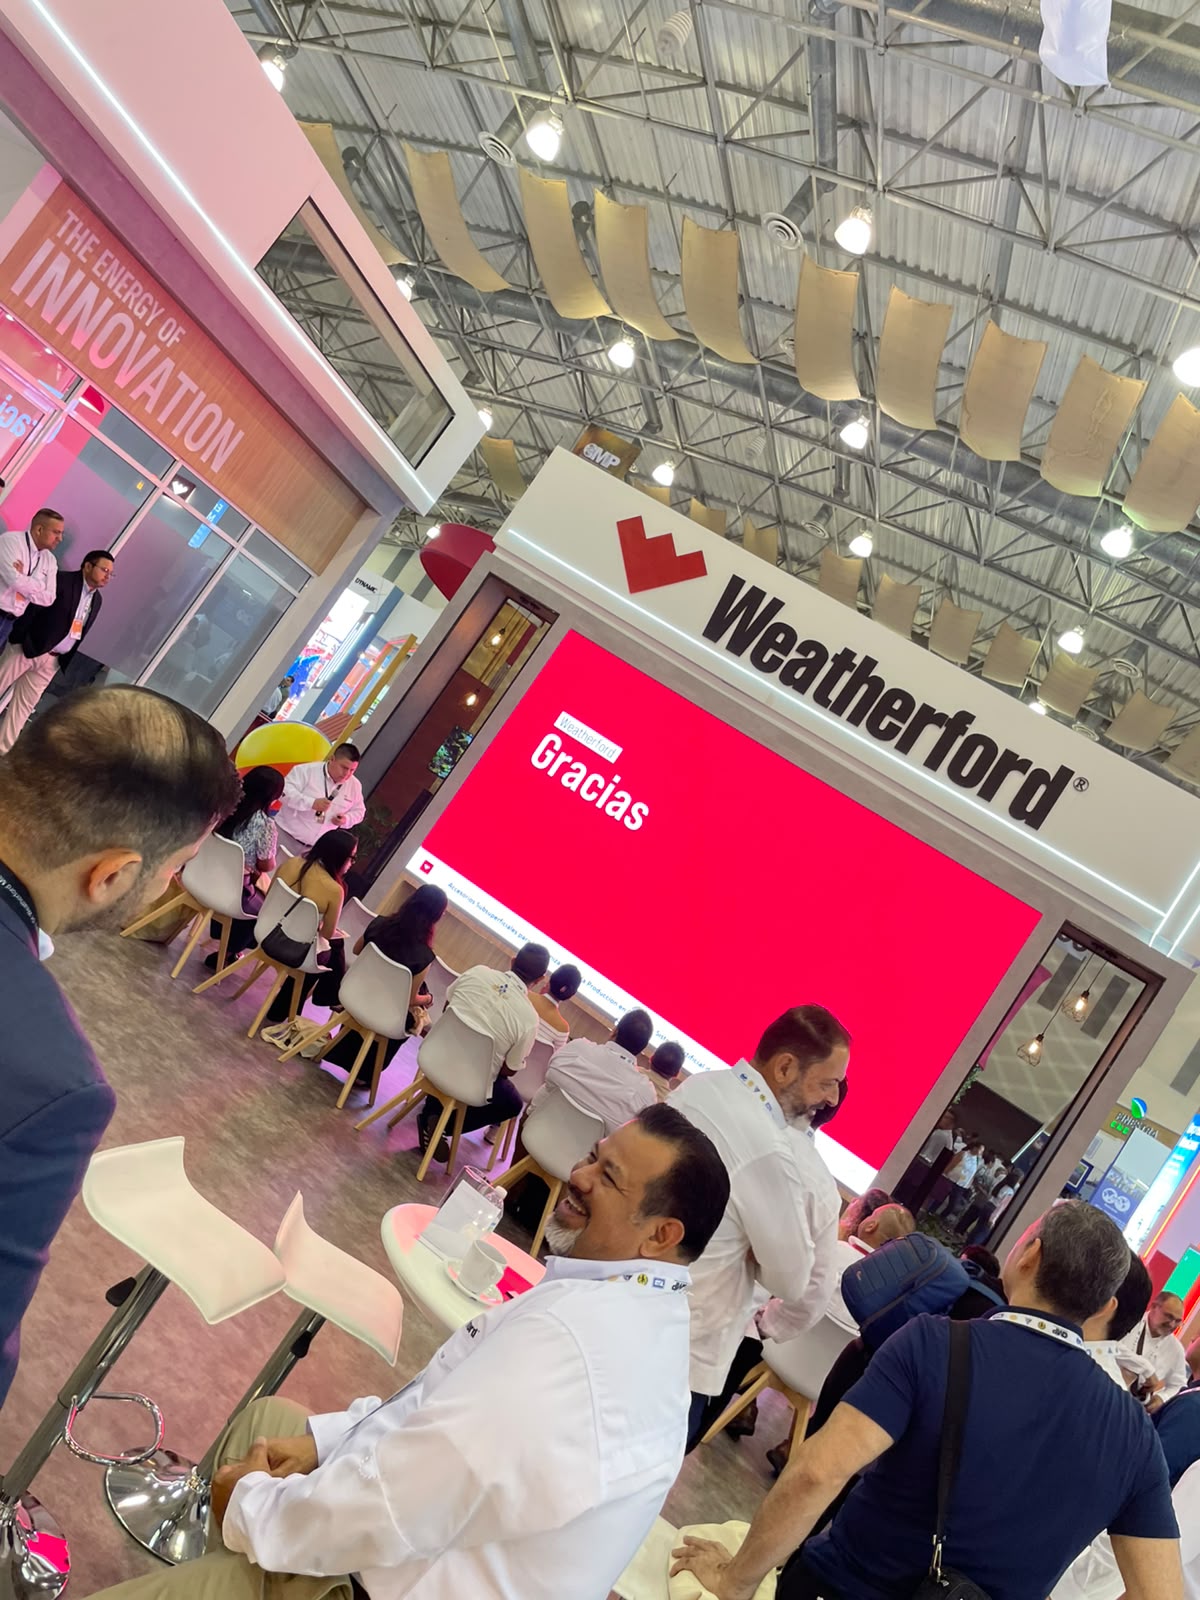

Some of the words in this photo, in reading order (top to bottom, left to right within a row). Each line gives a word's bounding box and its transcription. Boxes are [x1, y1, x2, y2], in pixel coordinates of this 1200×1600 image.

[56, 209, 100, 263] THE
[91, 248, 166, 327] ENERGY
[157, 316, 187, 348] OF
[10, 238, 245, 474] INNOVATION
[531, 733, 649, 831] Gracias
[560, 715, 618, 759] Weatherford
